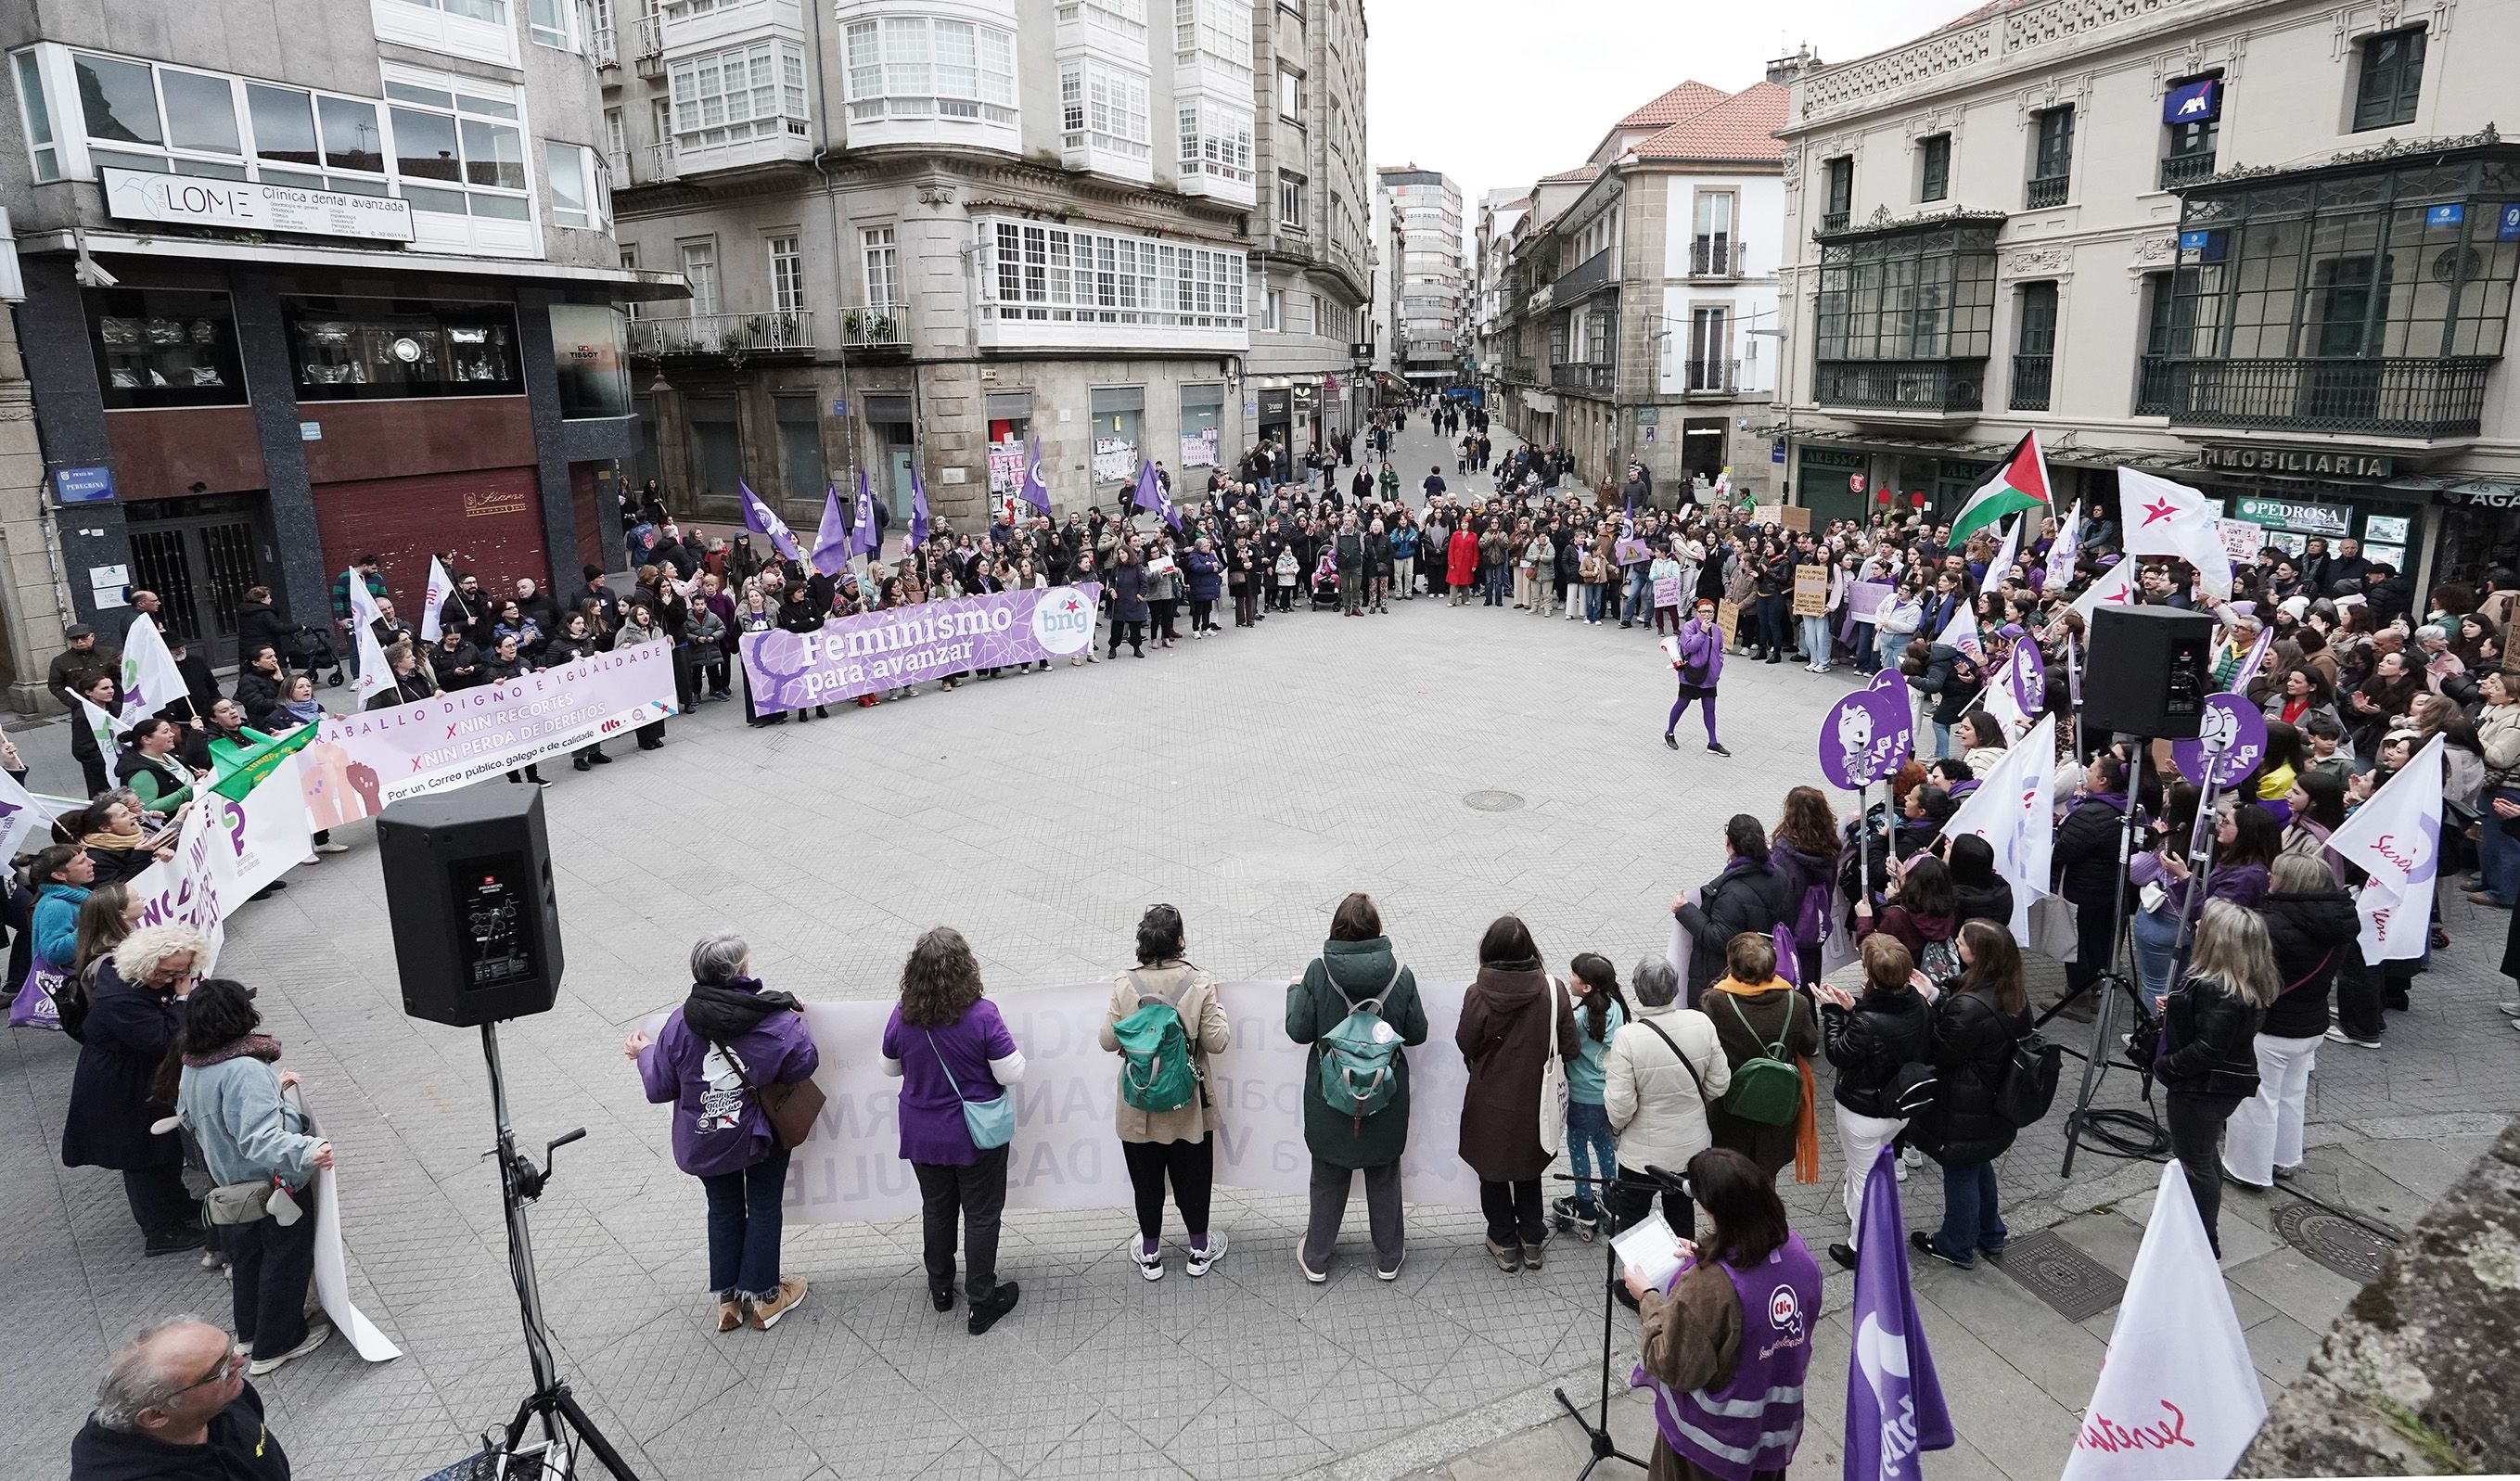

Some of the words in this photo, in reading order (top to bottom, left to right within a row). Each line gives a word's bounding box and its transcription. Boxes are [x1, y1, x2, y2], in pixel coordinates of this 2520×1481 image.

[2178, 95, 2207, 116] AXA
[165, 184, 253, 217] LOME
[262, 187, 306, 202] Clínica
[312, 193, 346, 206] dental
[352, 199, 404, 212] avanzada
[1807, 451, 1859, 465] ARESSO
[2199, 447, 2386, 477] INMOBILIARIA
[2256, 503, 2339, 521] PEDROSA
[799, 606, 1013, 667] Feminismo
[1043, 609, 1088, 634] bng
[803, 666, 866, 700] para
[874, 641, 974, 679] avanzar
[314, 709, 426, 746] RABALLO
[444, 686, 522, 713] DIGNO
[537, 680, 543, 691] E
[556, 646, 661, 685] IGUALDADE
[460, 715, 492, 735] NIN
[496, 692, 575, 725] RECORTES
[423, 746, 460, 768] NIN
[462, 731, 518, 758] PERDA
[520, 725, 541, 740] DE
[544, 702, 606, 731] DEREITOS
[388, 786, 408, 799] Por
[410, 784, 426, 795] un
[429, 769, 462, 788] Correo
[466, 760, 505, 781] público,
[506, 747, 538, 767] galego
[539, 745, 545, 753] e
[547, 739, 560, 752] de
[562, 729, 595, 747] calidade
